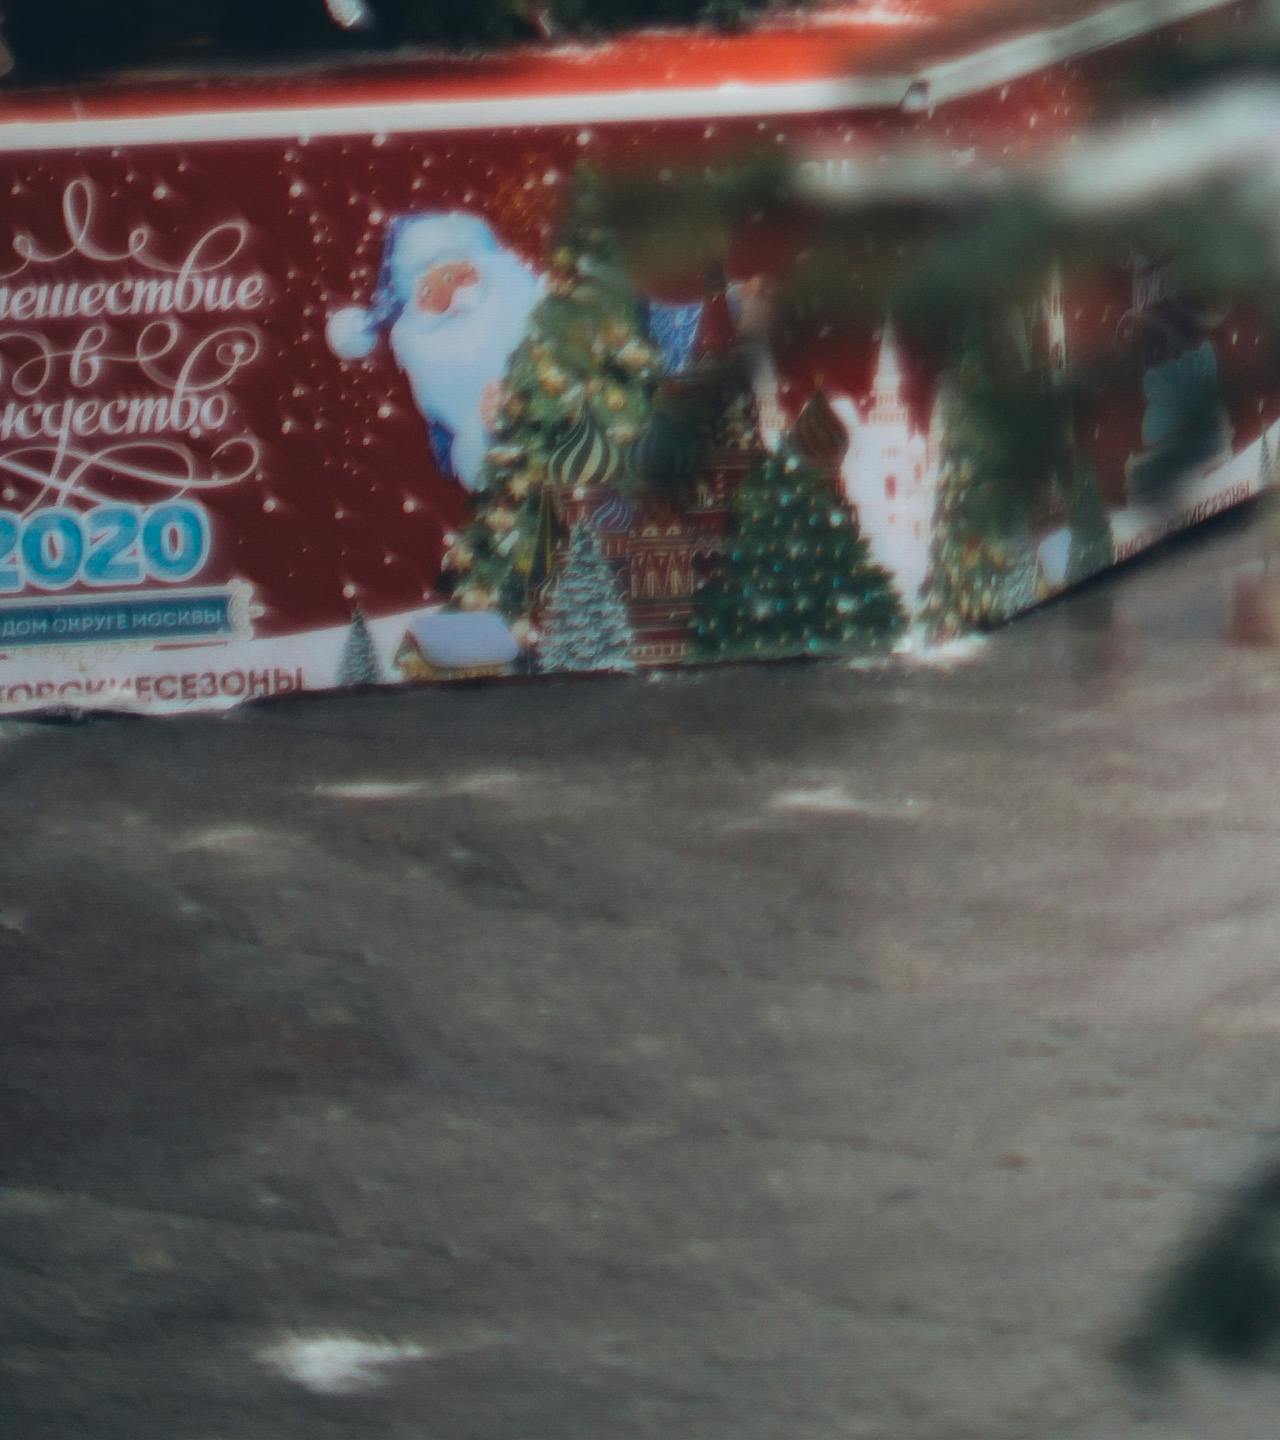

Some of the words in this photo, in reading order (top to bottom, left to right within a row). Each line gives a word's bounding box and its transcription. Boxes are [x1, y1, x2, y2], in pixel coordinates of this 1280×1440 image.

[70, 326, 107, 388] в
[52, 612, 128, 633] ОКРУГЕ
[132, 607, 222, 629] МОСКВЫ
